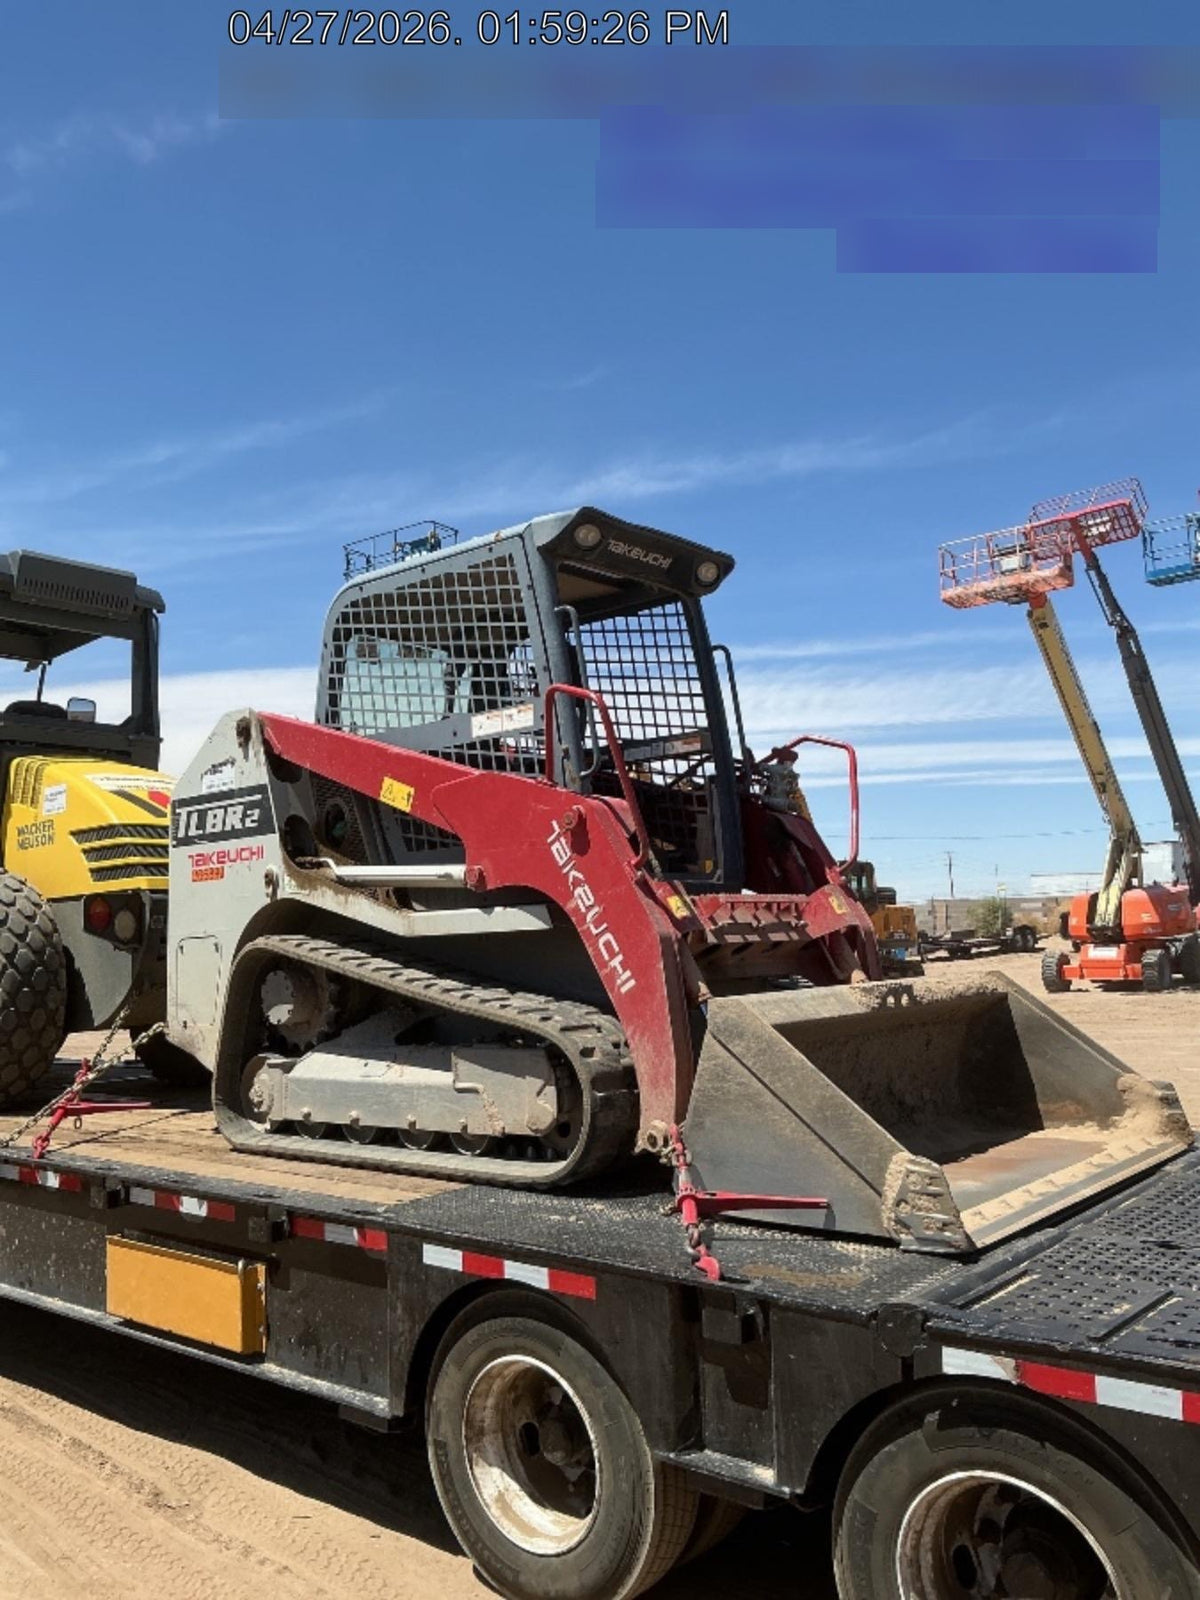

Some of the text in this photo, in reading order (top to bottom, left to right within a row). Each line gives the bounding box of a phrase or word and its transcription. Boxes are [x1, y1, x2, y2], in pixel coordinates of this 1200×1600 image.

[608, 538, 673, 570] TAKEUCHI
[16, 819, 54, 837] WACKER
[17, 834, 54, 850] NEUSON
[188, 845, 263, 868] TAKEUCHI
[547, 819, 637, 994] TAKEUCHI
